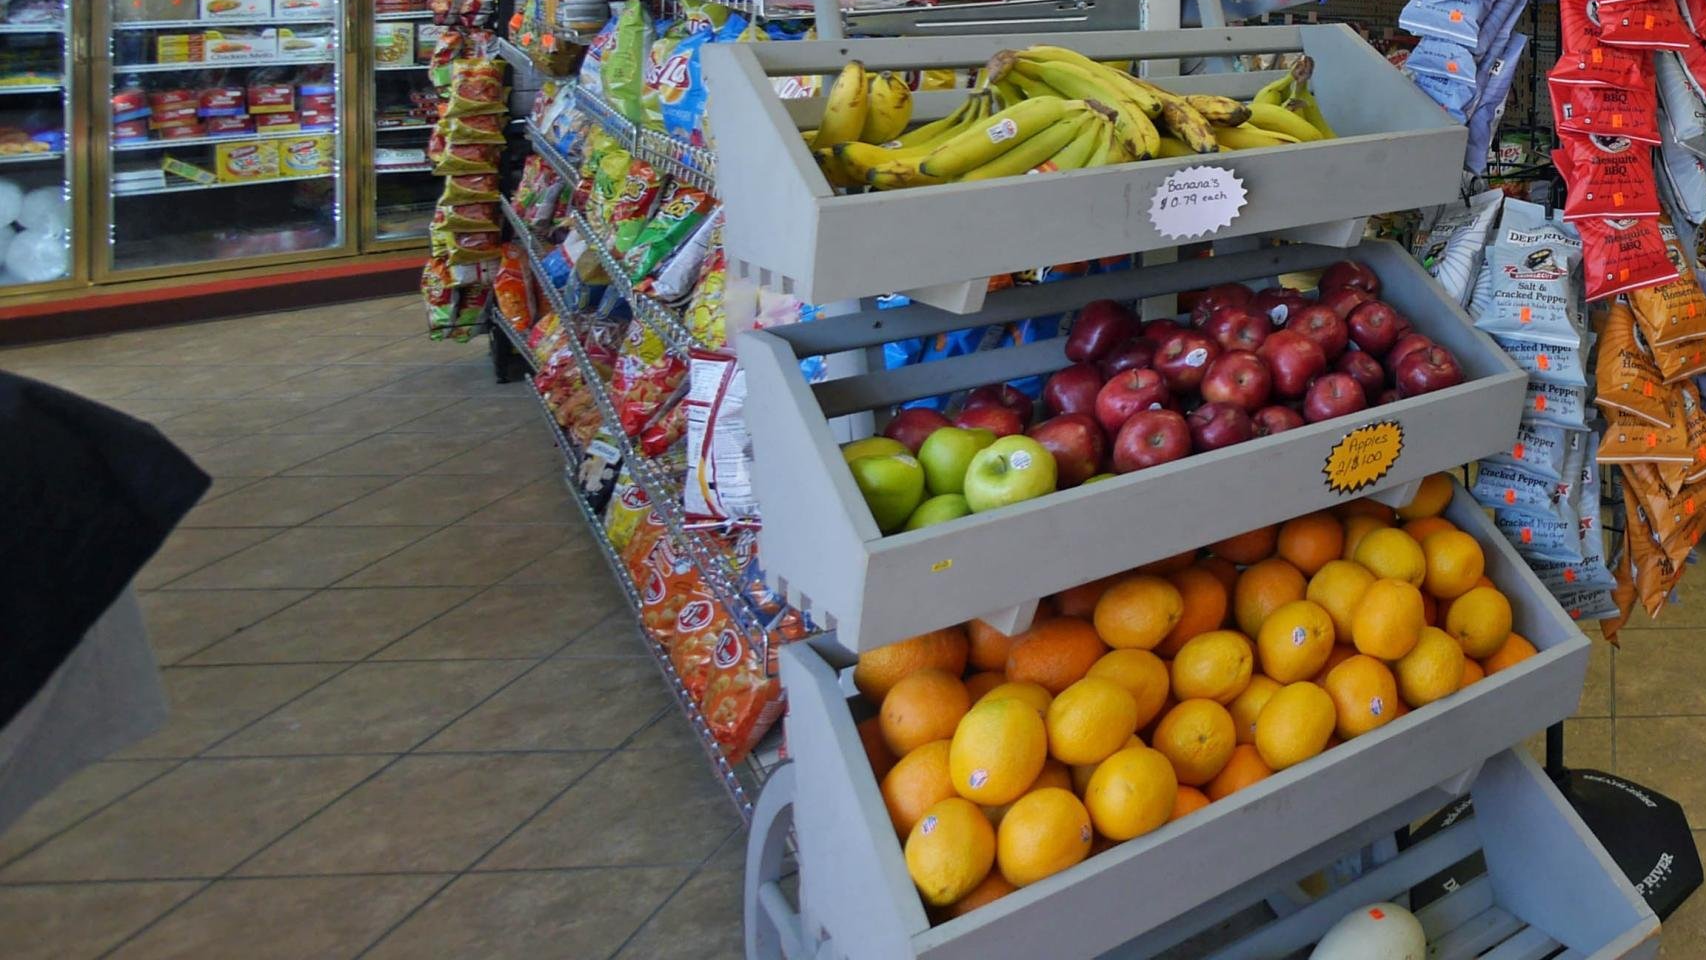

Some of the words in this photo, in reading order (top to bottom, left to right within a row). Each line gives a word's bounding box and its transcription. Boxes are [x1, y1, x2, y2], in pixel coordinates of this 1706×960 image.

[1603, 92, 1627, 104] BBQ
[1592, 156, 1638, 166] Mesquite
[1604, 165, 1627, 176] BBQ
[1167, 178, 1220, 192] Banana's
[1202, 191, 1228, 202] each
[1509, 231, 1543, 243] DEEP
[1544, 233, 1582, 247] RIVER
[1604, 228, 1650, 244] Mesquite
[1619, 240, 1643, 253] BBQ
[1518, 282, 1537, 291] Salt
[1494, 290, 1533, 300] Cracked
[1535, 292, 1568, 304] Pepper
[1540, 343, 1572, 353] Pepper
[1548, 383, 1579, 397] Pepper
[1349, 433, 1389, 454] Apples
[1523, 432, 1555, 449] Pepper
[1480, 467, 1517, 482] Cracked
[1517, 473, 1548, 488] Pepper
[1499, 518, 1535, 528] Cracked
[1536, 518, 1568, 531] Pepper
[1643, 852, 1674, 888] RIVER
